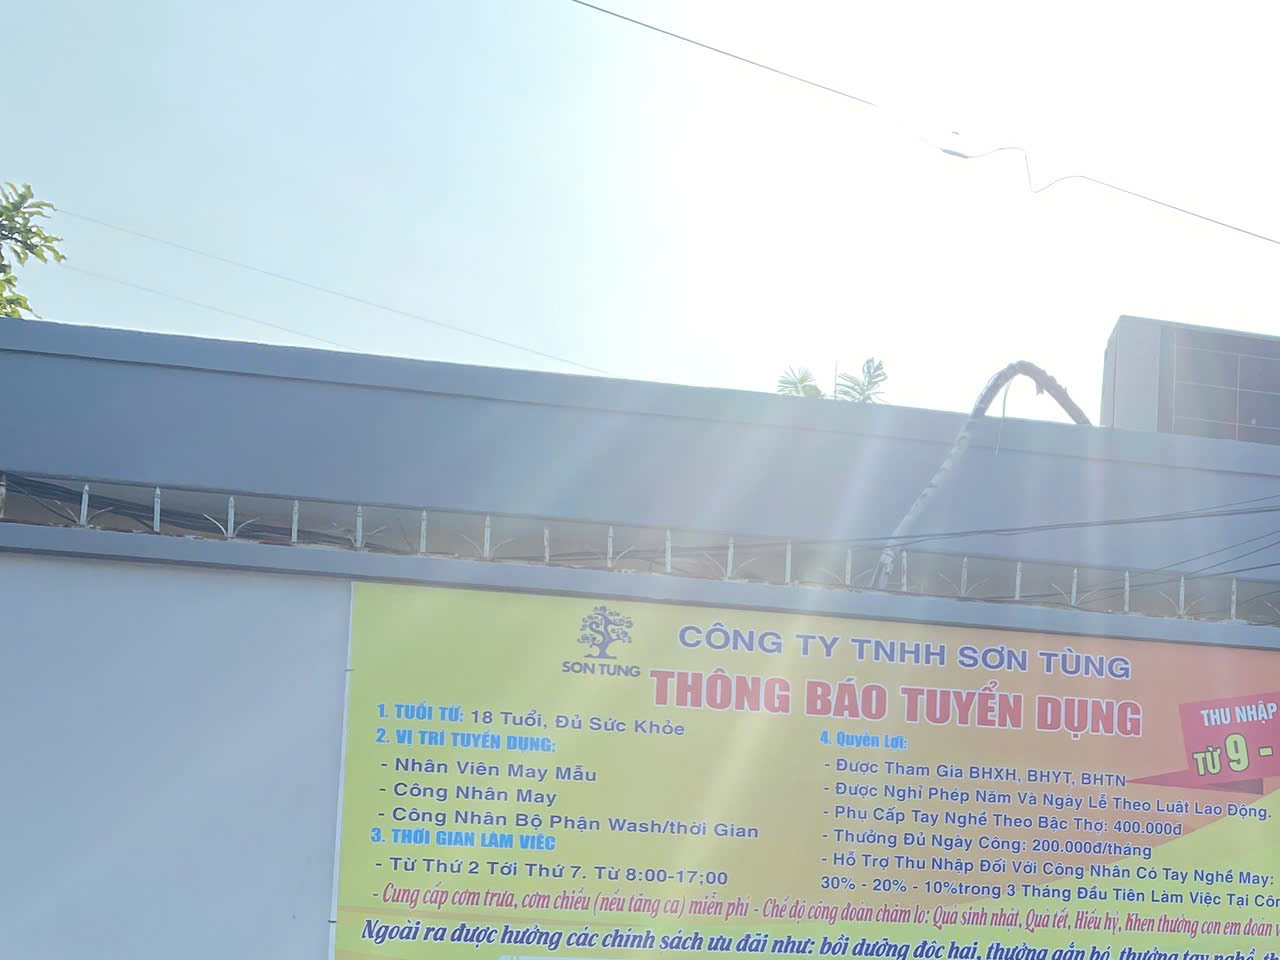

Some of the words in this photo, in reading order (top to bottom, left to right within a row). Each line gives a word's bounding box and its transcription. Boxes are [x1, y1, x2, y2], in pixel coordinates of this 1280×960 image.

[679, 622, 781, 653] CÔNG
[796, 634, 839, 656] TY
[850, 638, 945, 665] TNHH
[958, 646, 1026, 670] SƠN
[1039, 648, 1129, 678] TÙNG
[649, 667, 789, 712] THÔNG
[806, 678, 886, 719] BÁO
[901, 680, 1021, 727] TUYỂN
[1037, 696, 1140, 739] DỤNG
[1201, 708, 1231, 726] THU
[1235, 700, 1277, 724] NHẬP
[471, 710, 492, 724] 18
[499, 709, 546, 729] Tuổi,
[554, 713, 581, 729] Đủ
[588, 716, 626, 732] Sức
[634, 719, 684, 735] Khỏe
[394, 757, 447, 773] Nhân
[456, 760, 499, 776] Viên
[507, 763, 547, 782] May
[555, 764, 596, 781] Mẫu
[1193, 746, 1221, 776] TỪ
[1225, 732, 1249, 772] 9
[835, 758, 878, 775] Được
[883, 761, 929, 776] Tham
[936, 764, 962, 778] Gia
[969, 766, 1020, 782] BHXH,
[1027, 769, 1074, 786] BHYT,
[1081, 772, 1125, 786] BHTN
[393, 782, 447, 801] Công
[455, 785, 507, 801] Nhân
[516, 788, 556, 807] May
[834, 781, 877, 798] Được
[883, 784, 923, 801] Nghỉ
[928, 786, 969, 804] Phép
[975, 789, 1010, 803] Năm
[1017, 791, 1036, 805] Và
[1042, 793, 1082, 810] Ngày
[1088, 793, 1107, 808] Lễ
[1111, 797, 1150, 811] Theo
[1156, 799, 1189, 813] Luật
[1194, 801, 1222, 815] Lao
[1227, 803, 1271, 820] Động.
[392, 807, 446, 826] Công
[454, 810, 506, 825] Nhân
[515, 813, 542, 830] Bộ
[549, 814, 599, 832] Phận
[713, 822, 758, 838] Gian
[834, 805, 867, 822] Phụ
[872, 806, 905, 824] Cấp
[911, 809, 938, 826] Tay
[944, 810, 987, 828] Nghề
[992, 813, 1032, 827] Theo
[1038, 815, 1067, 832] Bậc
[1073, 817, 1107, 831] Thợ:
[1113, 820, 1181, 838] 400.000đ
[833, 828, 896, 848] Thưởng
[903, 831, 925, 846] Đủ
[931, 833, 972, 851] Ngày
[978, 835, 1025, 853] Công:
[1032, 838, 1151, 860] 200.000đ/tháng
[389, 856, 417, 871] Từ
[422, 858, 463, 873] Thứ
[467, 860, 479, 874] 2
[485, 861, 517, 875] Tới
[524, 863, 565, 877] Thứ
[569, 865, 586, 878] 7.
[593, 866, 621, 880] Từ
[833, 850, 855, 866] Hỗ
[861, 853, 889, 870] Trợ
[893, 855, 925, 869] Thu
[931, 857, 973, 874] Nhập
[979, 858, 1005, 872] Đối
[1011, 860, 1036, 873] Với
[1042, 862, 1084, 879] Công
[1090, 864, 1130, 878] Nhân
[1136, 866, 1157, 879] Có
[1161, 867, 1188, 884] Tay
[1193, 868, 1233, 885] Nghề
[1238, 871, 1273, 888] May:
[820, 875, 855, 889] 30%
[872, 878, 907, 892] 20%
[1006, 883, 1015, 896] 3
[1020, 884, 1071, 902] Tháng
[1076, 885, 1107, 900] Đầu
[1112, 887, 1144, 902] Tiên
[1151, 889, 1183, 903] Làm
[1188, 891, 1221, 907] Việc
[1225, 893, 1248, 908] Tại
[361, 919, 420, 944] Ngoài
[422, 926, 447, 941] ra
[450, 922, 497, 948] được
[500, 924, 562, 950] hưởng
[565, 926, 599, 947] các
[601, 927, 655, 948] chính
[658, 929, 703, 950] sách
[707, 935, 732, 951] ưu
[735, 932, 768, 952] đãi
[770, 935, 815, 954] như:
[819, 933, 849, 955] bồi
